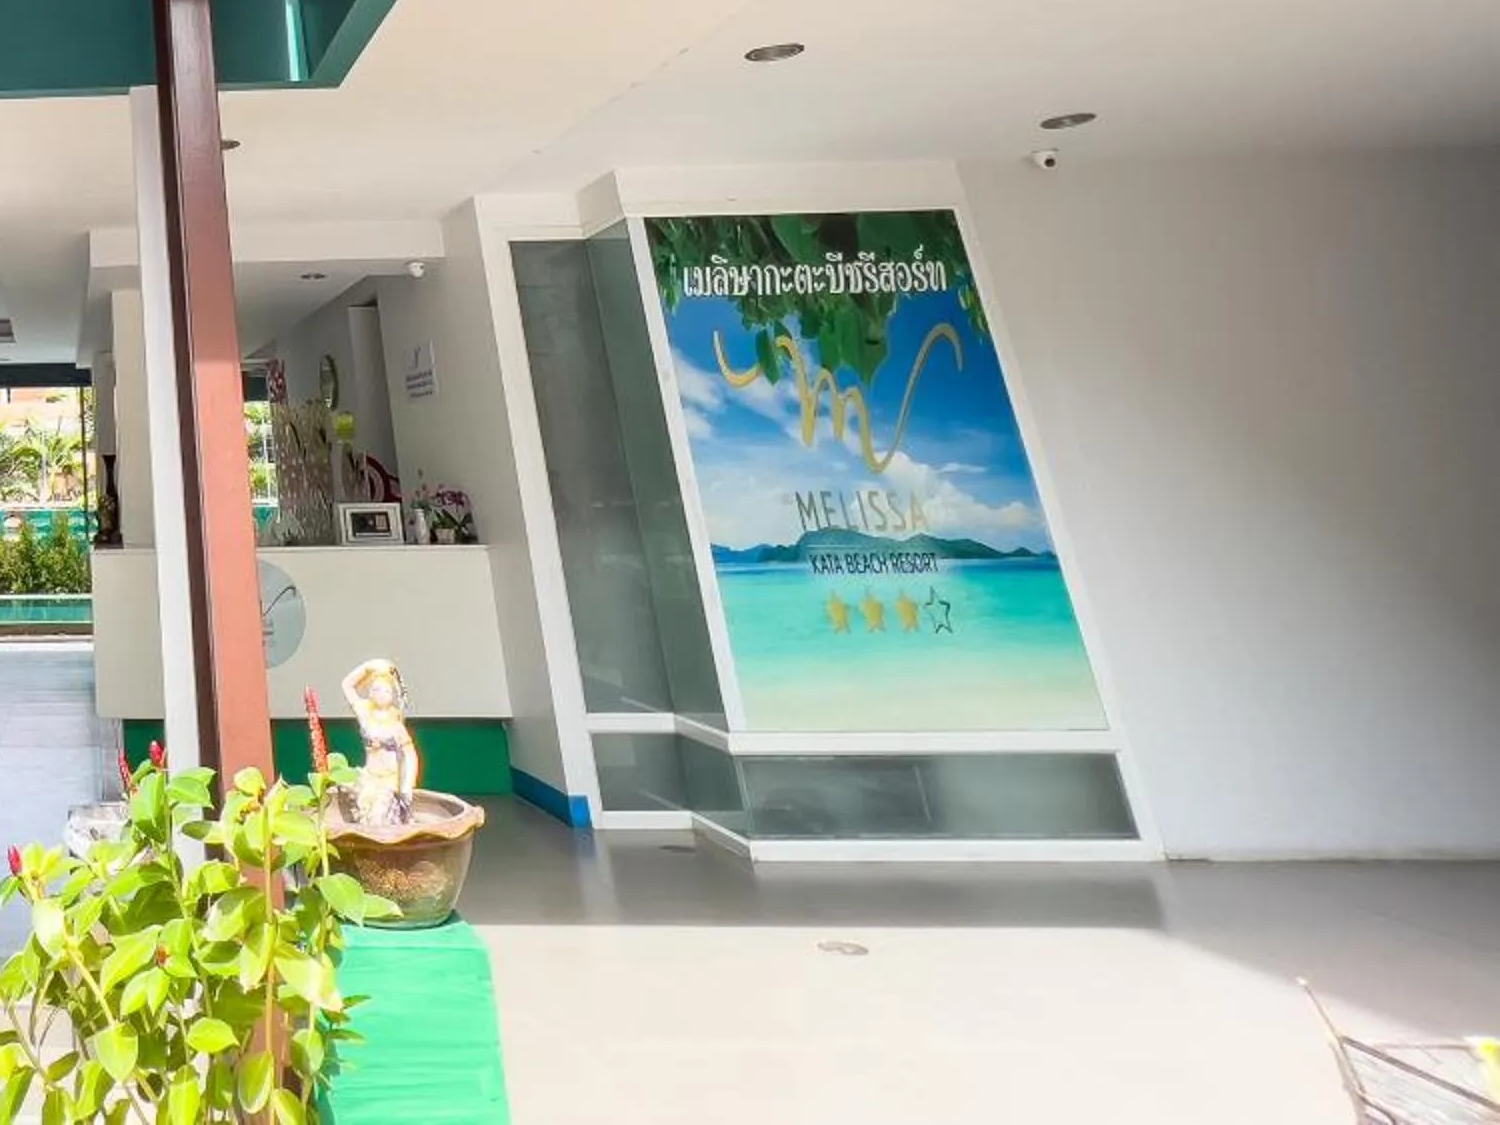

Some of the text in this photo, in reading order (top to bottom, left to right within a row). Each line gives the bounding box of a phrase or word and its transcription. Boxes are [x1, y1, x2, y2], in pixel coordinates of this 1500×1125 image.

[795, 489, 929, 532] MELISSA
[810, 551, 939, 575] KATA BEACH RESORT
